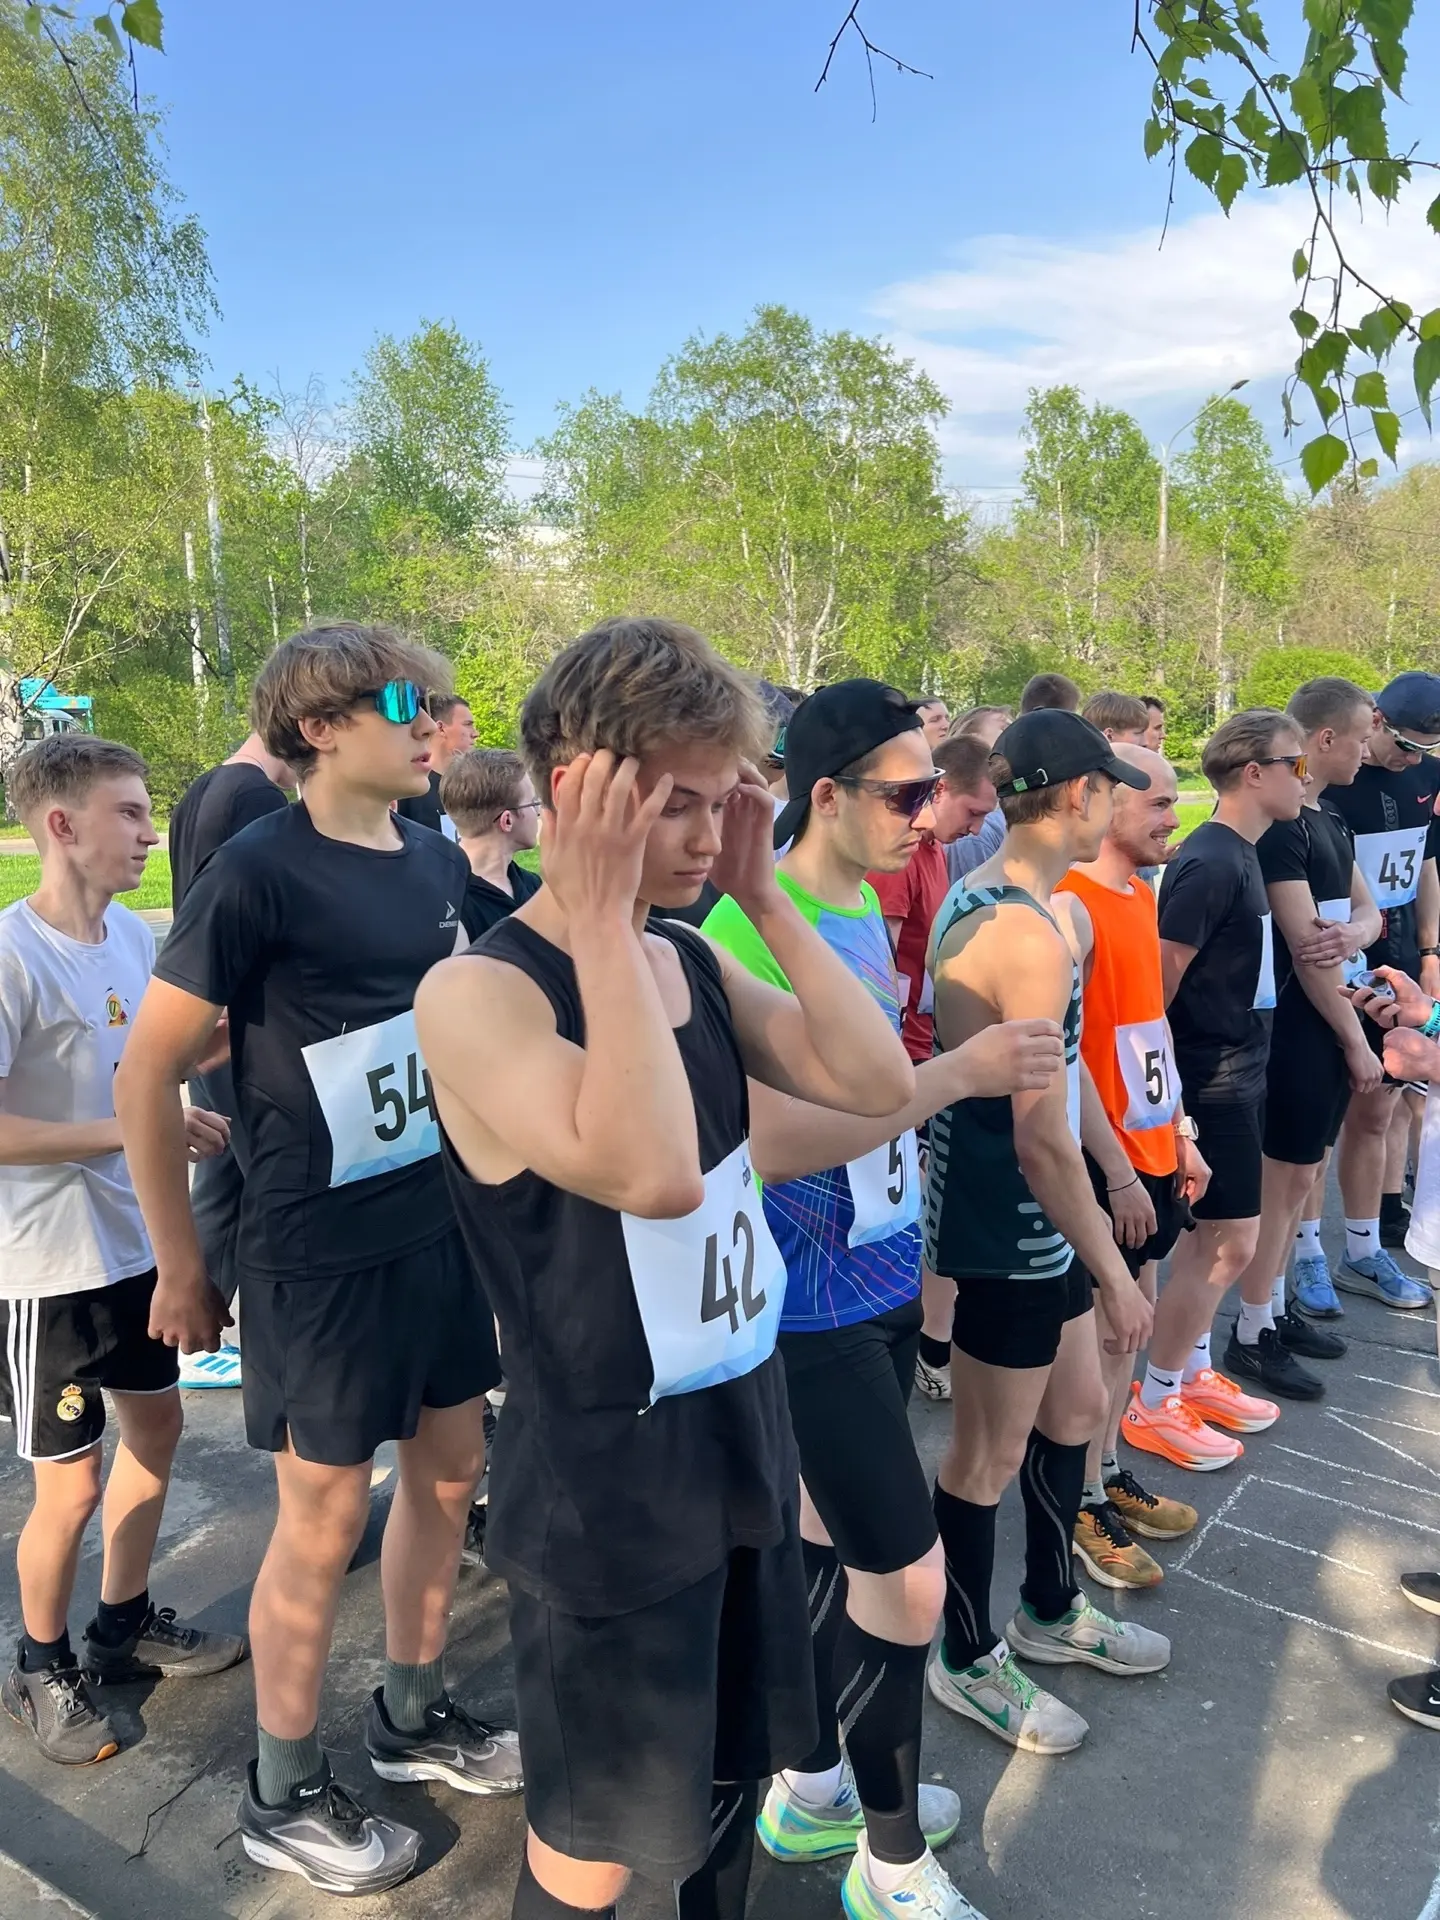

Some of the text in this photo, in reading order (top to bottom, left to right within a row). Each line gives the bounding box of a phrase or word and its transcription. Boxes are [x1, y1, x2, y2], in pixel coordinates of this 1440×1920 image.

[1379, 850, 1416, 891] 43
[366, 1052, 439, 1142] 54
[701, 1210, 767, 1335] 42
